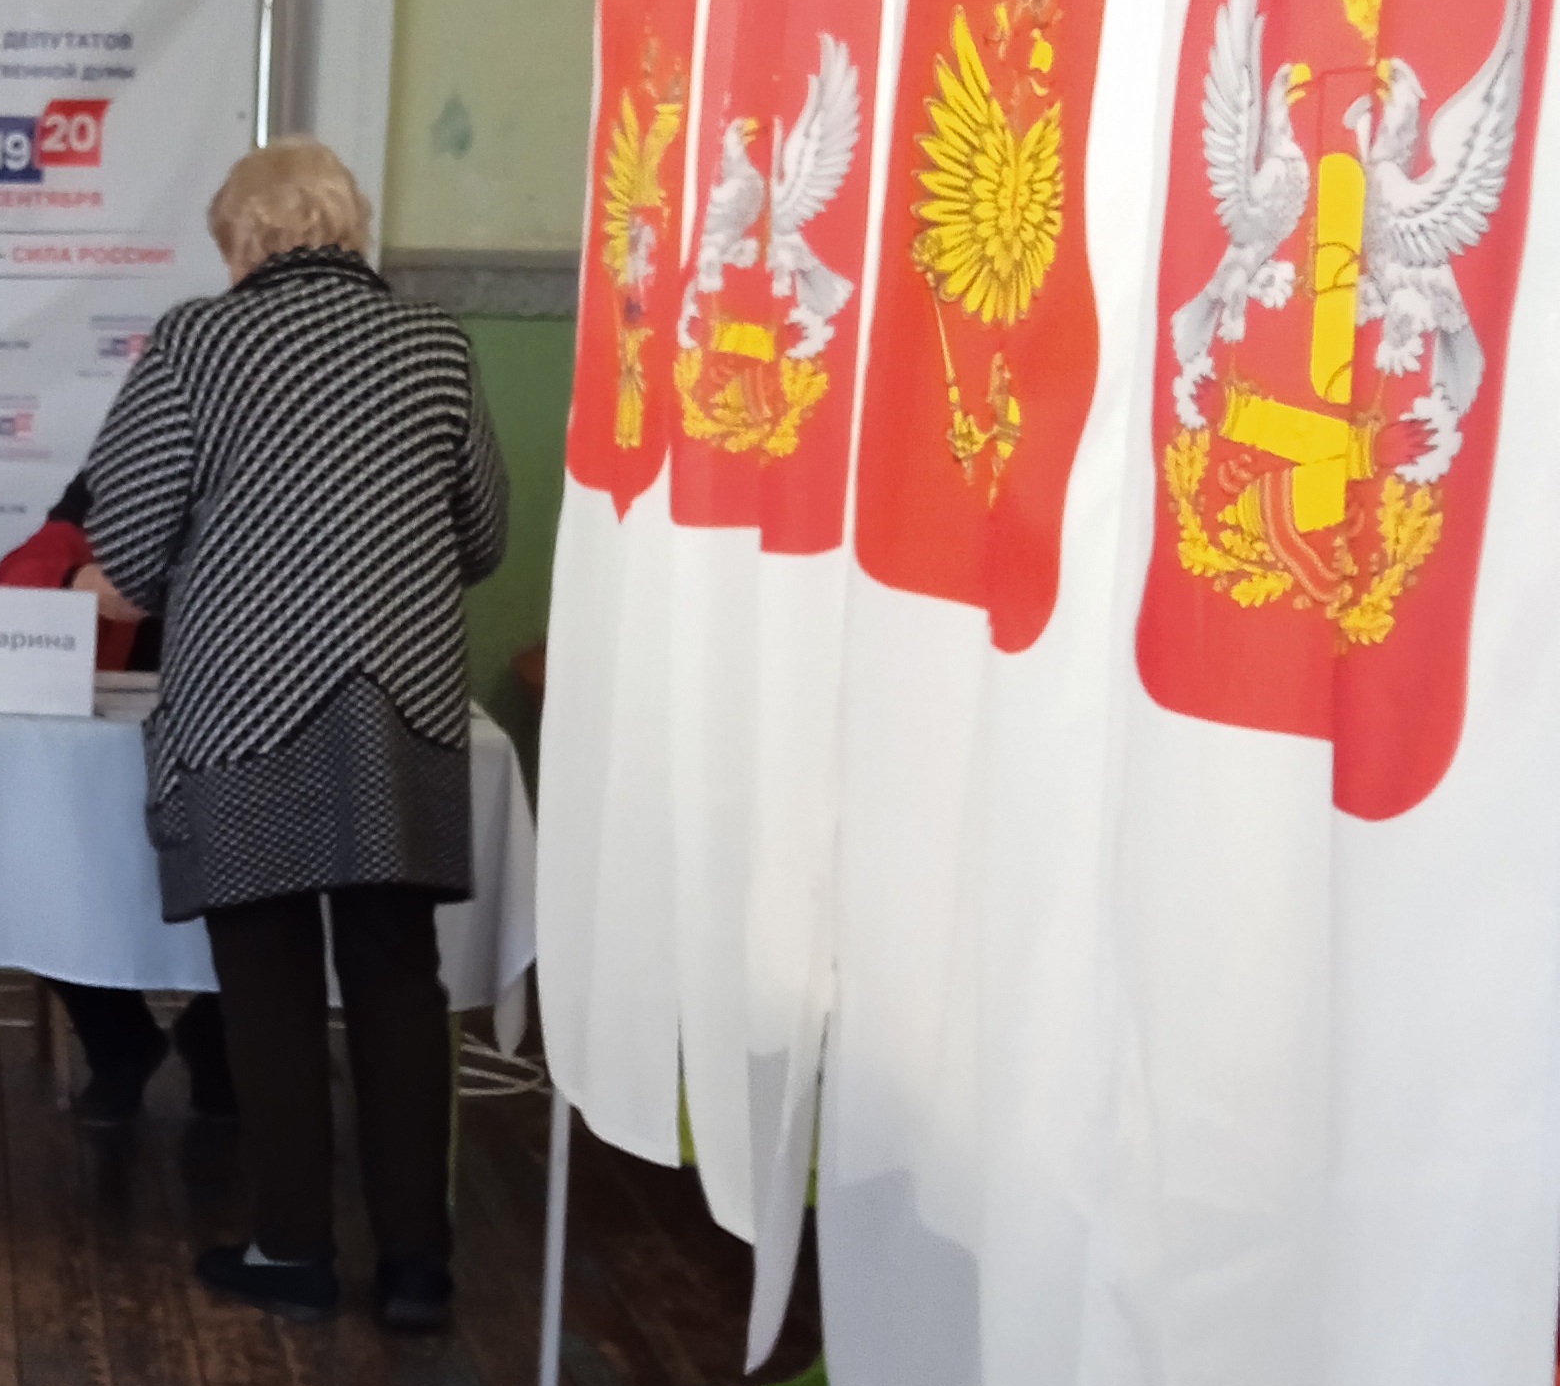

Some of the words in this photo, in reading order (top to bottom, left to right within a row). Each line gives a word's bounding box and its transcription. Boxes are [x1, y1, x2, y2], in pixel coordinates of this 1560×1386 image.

[3, 30, 134, 50] ДЕПУТАТОВ
[41, 114, 96, 153] 20
[11, 245, 72, 264] СИЛА
